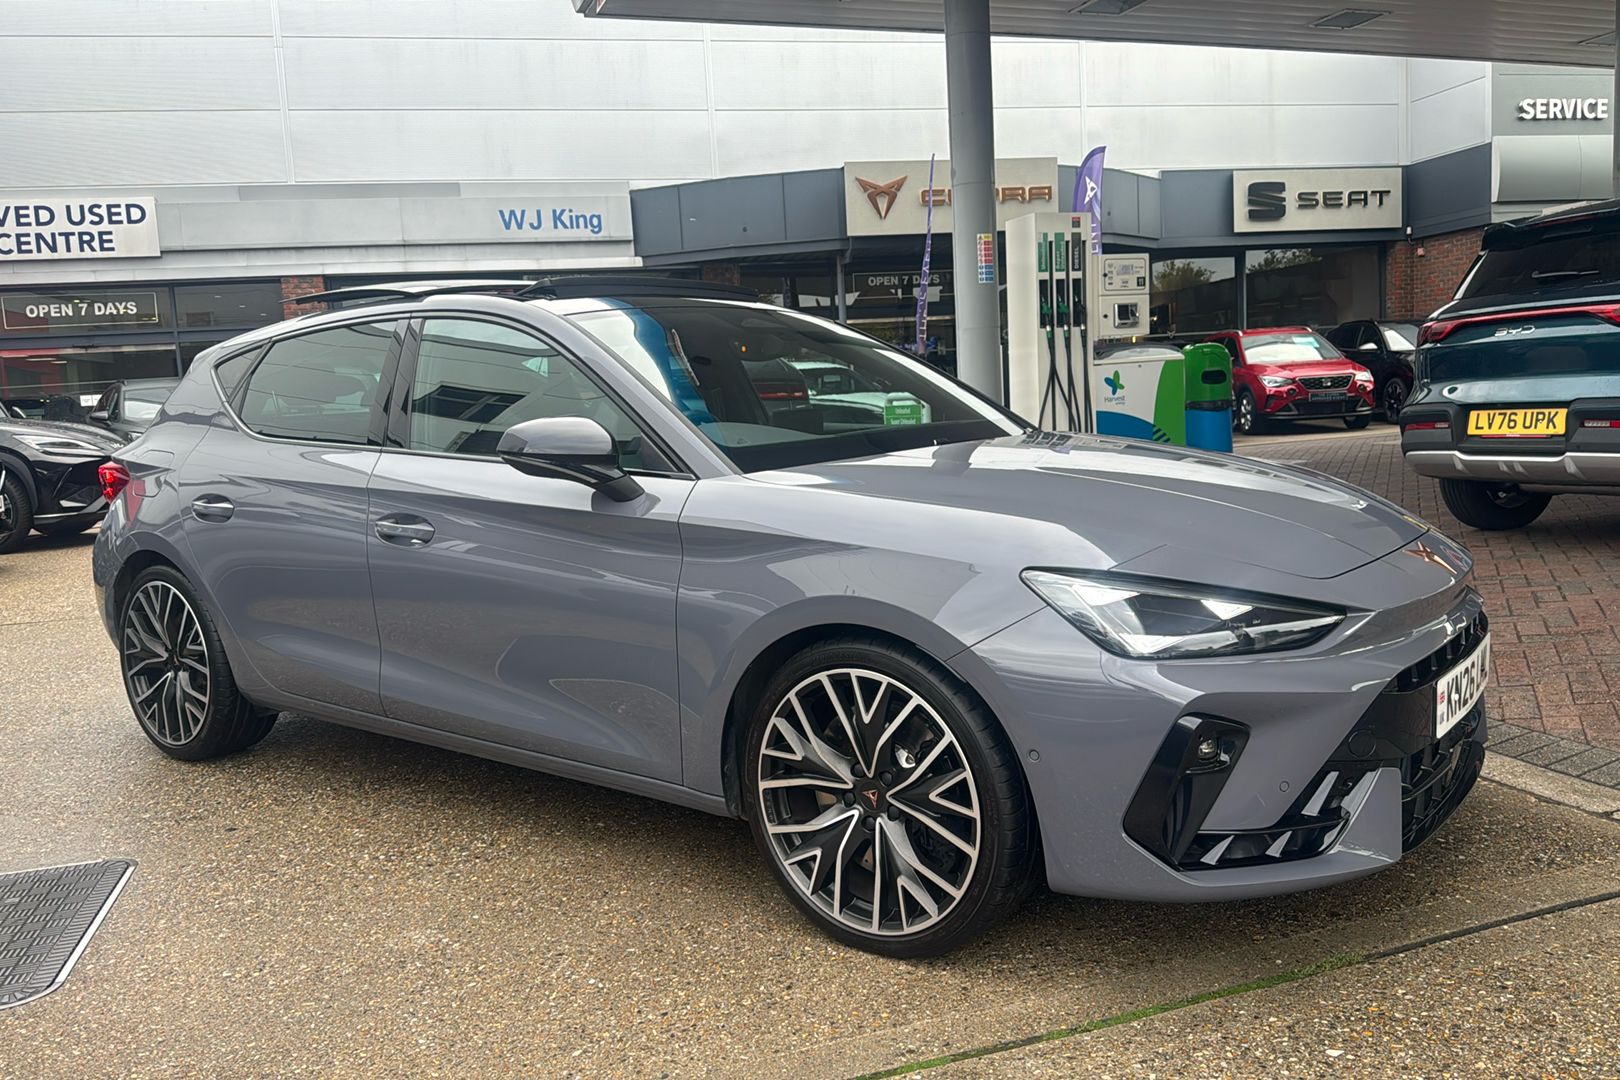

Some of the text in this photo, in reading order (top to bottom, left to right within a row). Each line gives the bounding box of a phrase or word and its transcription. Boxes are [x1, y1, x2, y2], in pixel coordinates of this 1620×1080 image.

[1519, 97, 1608, 120] SERVICE
[1296, 190, 1391, 209] SEAT
[66, 203, 147, 226] USED
[552, 208, 602, 234] King
[0, 231, 116, 256] CENTRE
[868, 276, 899, 287] OPEN
[902, 276, 909, 286] 7
[25, 301, 138, 318] OPEN 7 DAYS
[1495, 325, 1535, 337] BYD
[1475, 410, 1559, 430] LV76 UPK
[1446, 660, 1476, 722] KN26
